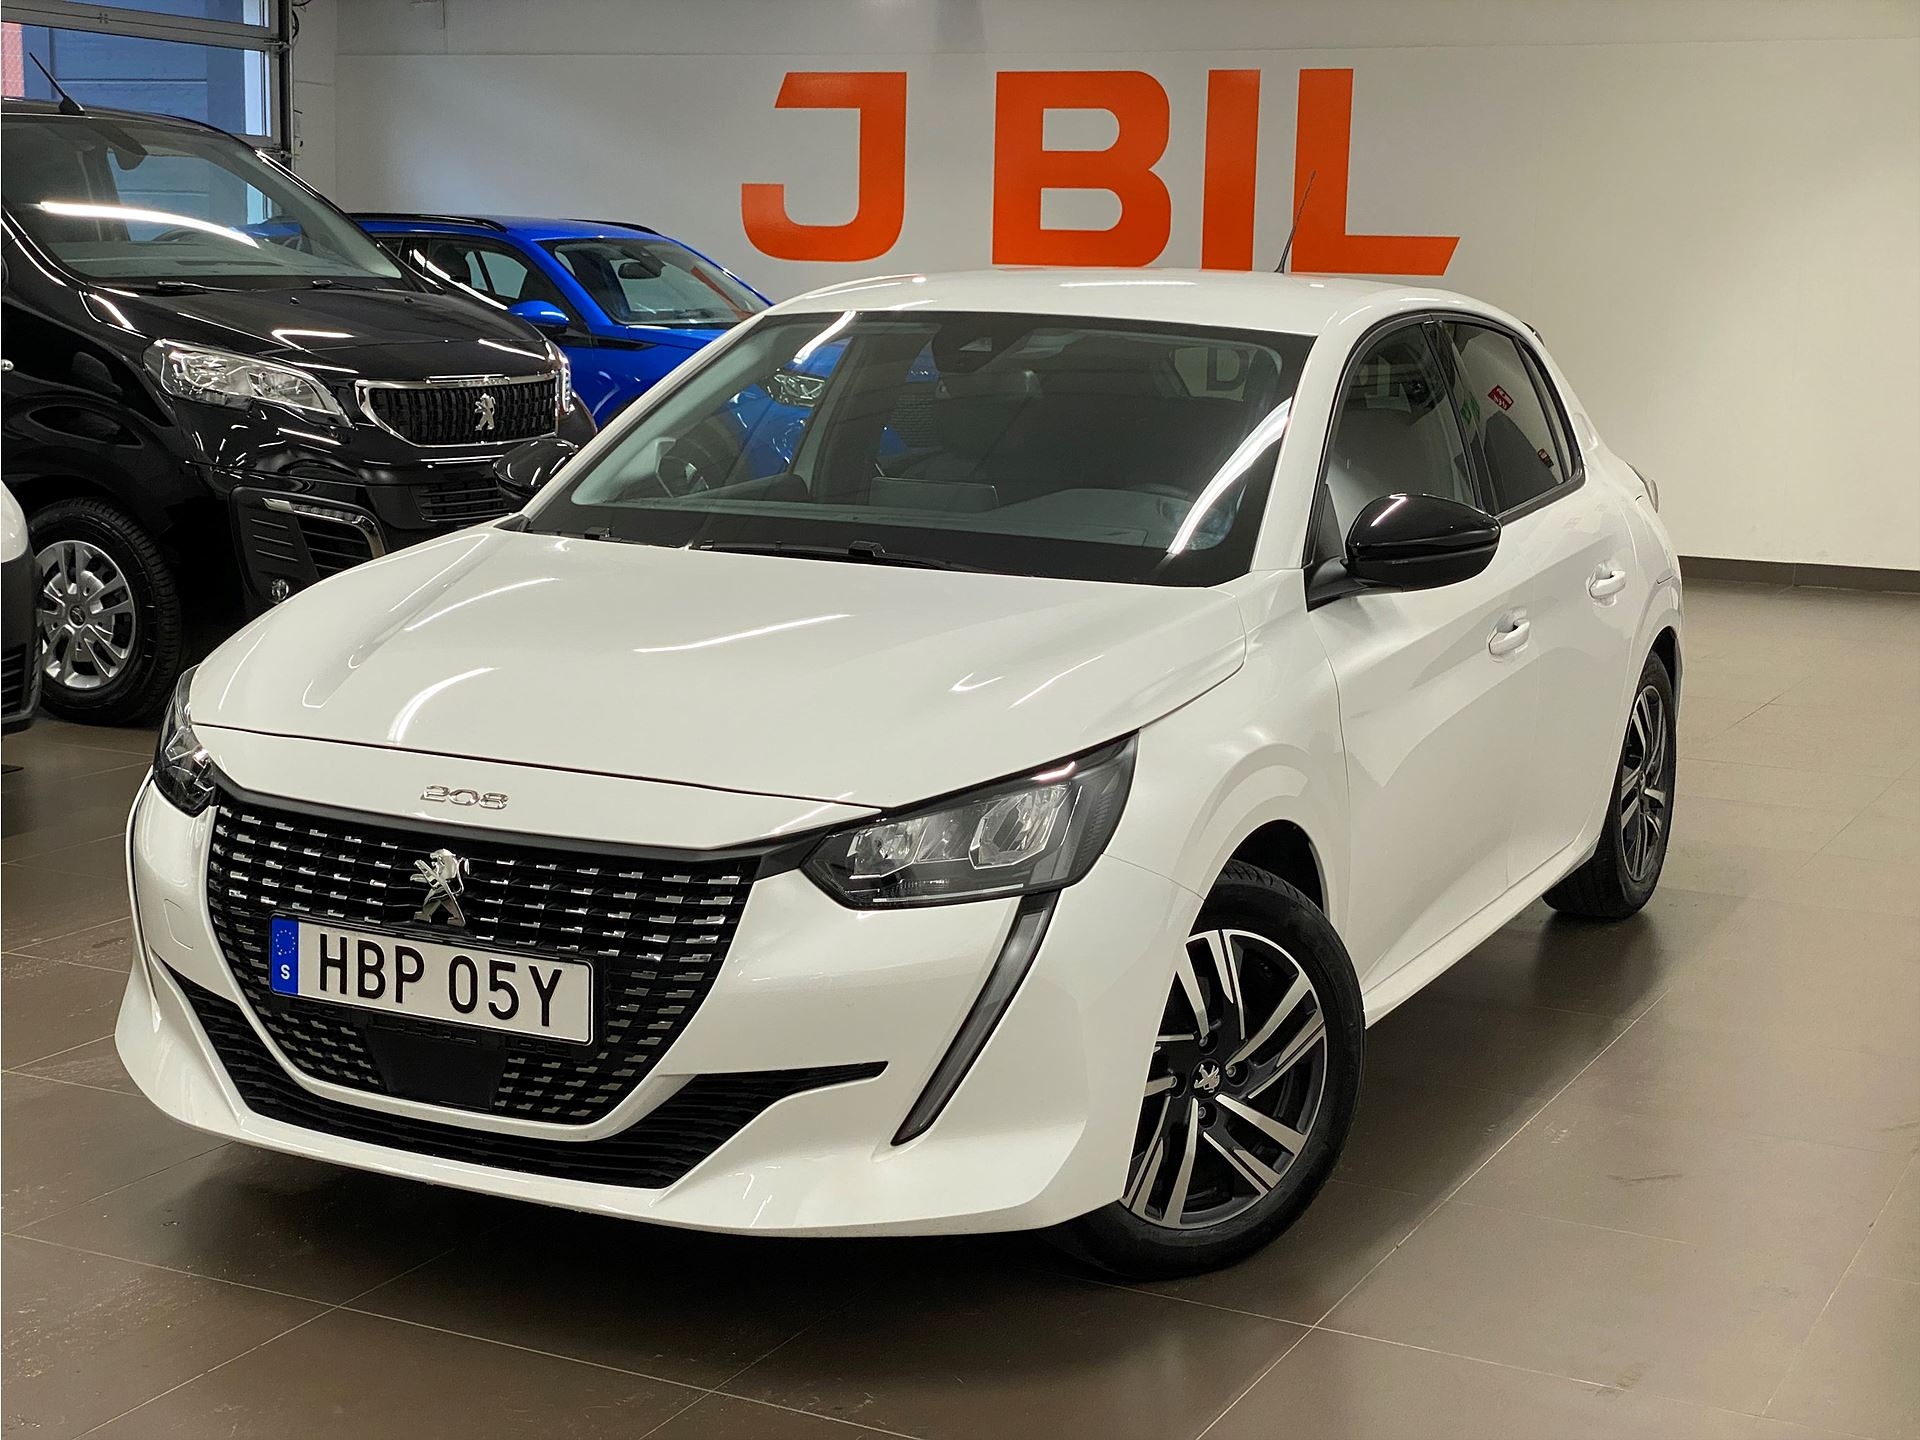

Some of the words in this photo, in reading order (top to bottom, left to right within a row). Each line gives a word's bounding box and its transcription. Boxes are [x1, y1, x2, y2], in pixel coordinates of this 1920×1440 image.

[741, 72, 907, 261] J
[992, 68, 1460, 276] BIL
[420, 785, 508, 809] 208
[281, 964, 290, 980] S
[319, 932, 425, 1003] HBP
[448, 955, 563, 1027] 05Y
